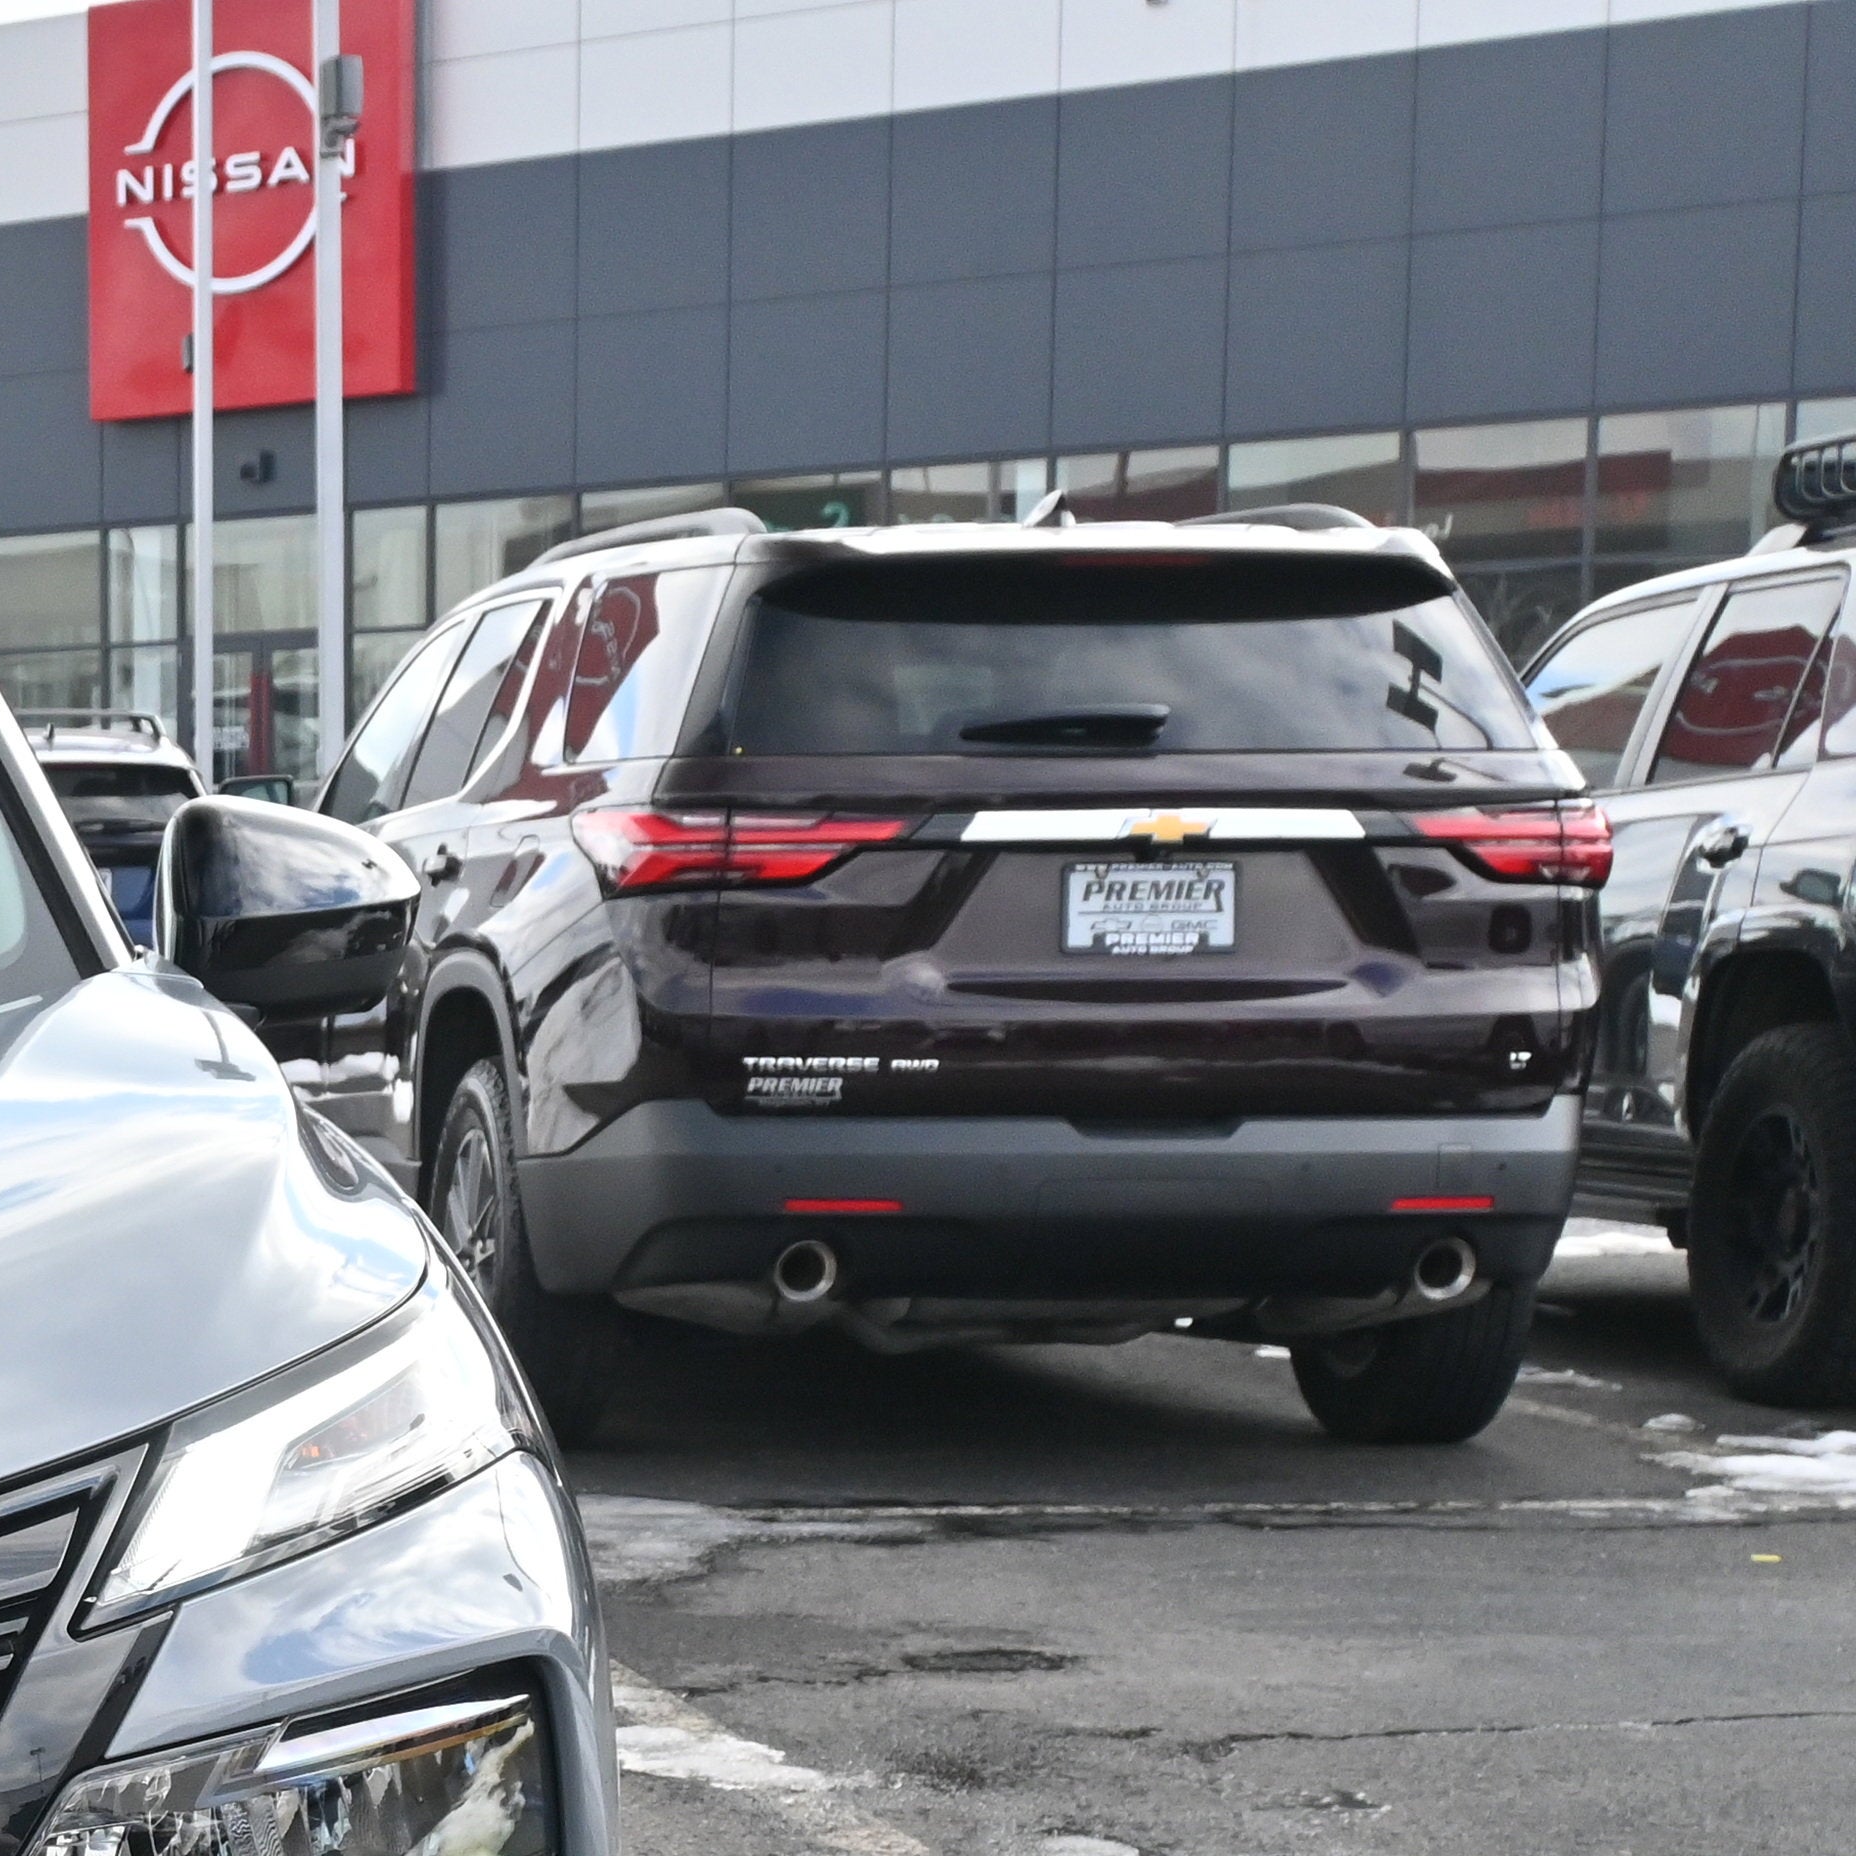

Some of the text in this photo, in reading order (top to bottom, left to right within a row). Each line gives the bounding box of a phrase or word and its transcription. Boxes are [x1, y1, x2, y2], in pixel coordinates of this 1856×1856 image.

[1082, 879, 1226, 912] PREMIER
[1105, 933, 1200, 946] PREMIER
[743, 1056, 880, 1073] TRAVERSE
[747, 1077, 844, 1100] PREMIER
